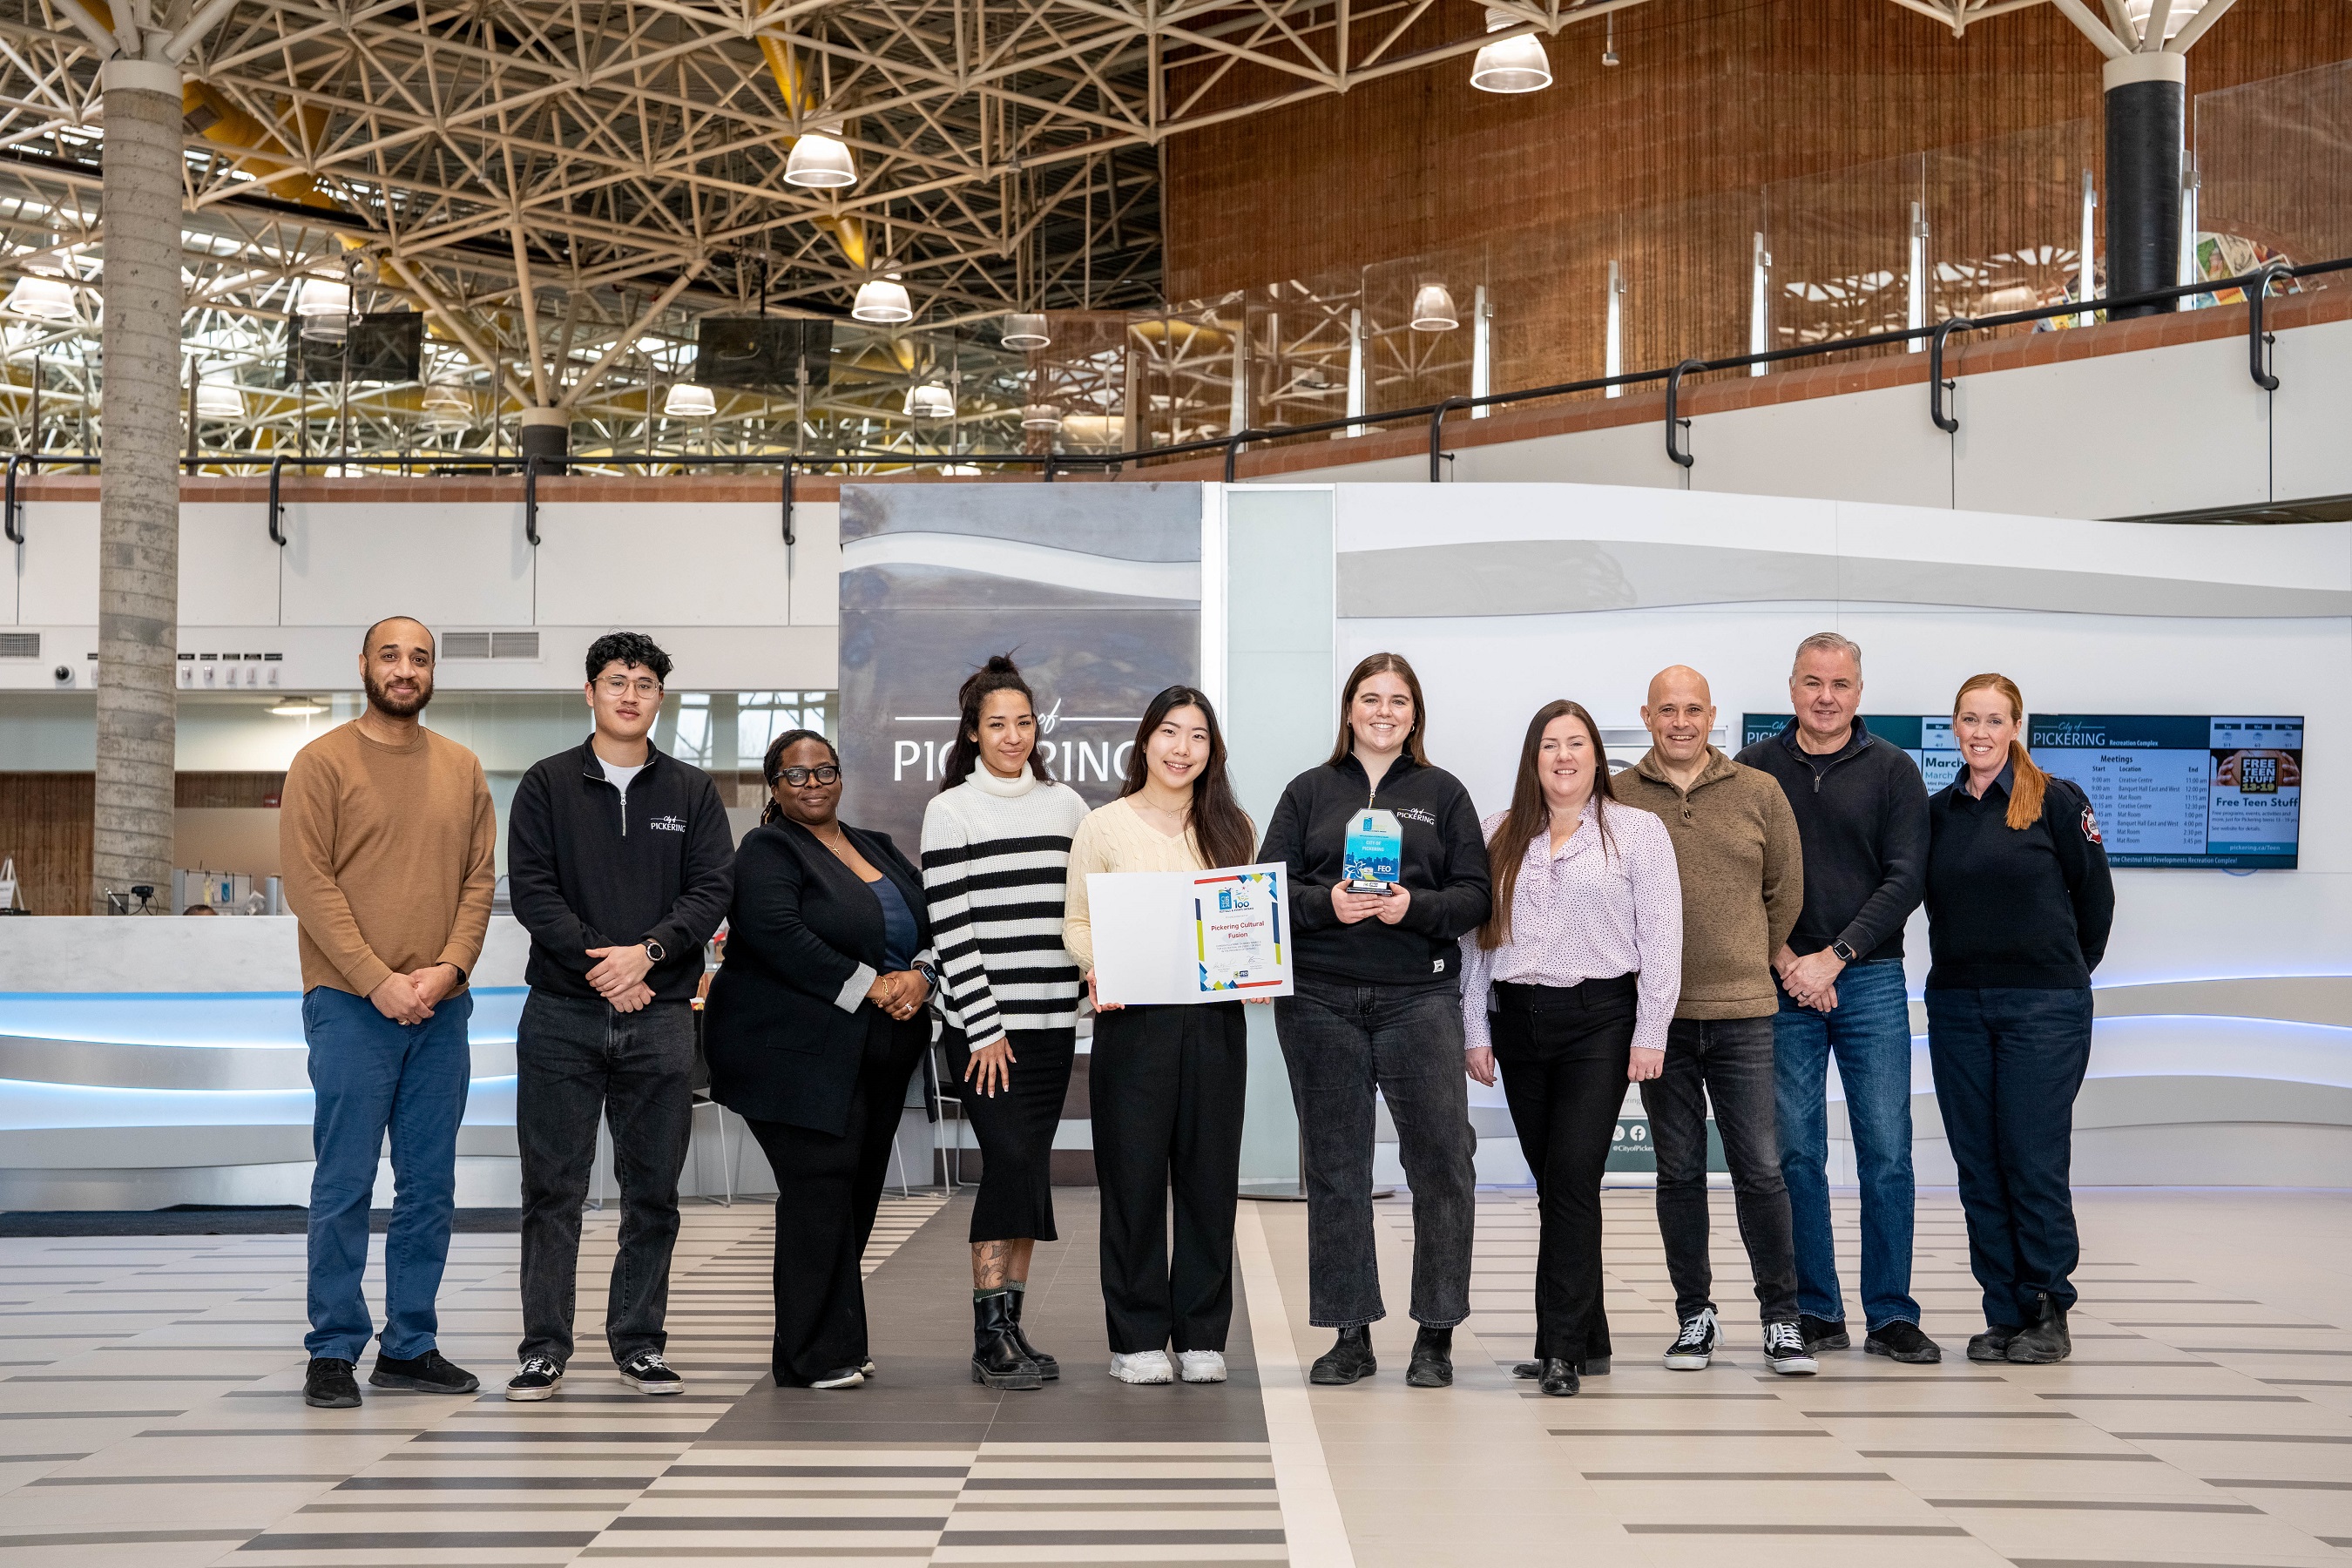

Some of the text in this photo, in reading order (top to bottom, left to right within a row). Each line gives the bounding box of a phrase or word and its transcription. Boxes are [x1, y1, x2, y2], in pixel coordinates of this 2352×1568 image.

[1037, 697, 1062, 733] of
[2058, 721, 2082, 733] City of
[2033, 733, 2105, 746] PICKERING
[2136, 740, 2159, 749] Complex
[1925, 757, 1964, 767] March
[2100, 754, 2133, 764] Meetings
[2242, 759, 2275, 768] FREE
[1925, 771, 1953, 780] March
[2241, 783, 2275, 792] 13-19
[2216, 797, 2298, 808] Free Teen Stuff
[1396, 812, 1434, 825] PICKERING
[651, 823, 686, 832] PICKERING
[1233, 899, 1250, 909] 100
[1240, 920, 1265, 929] Cultural
